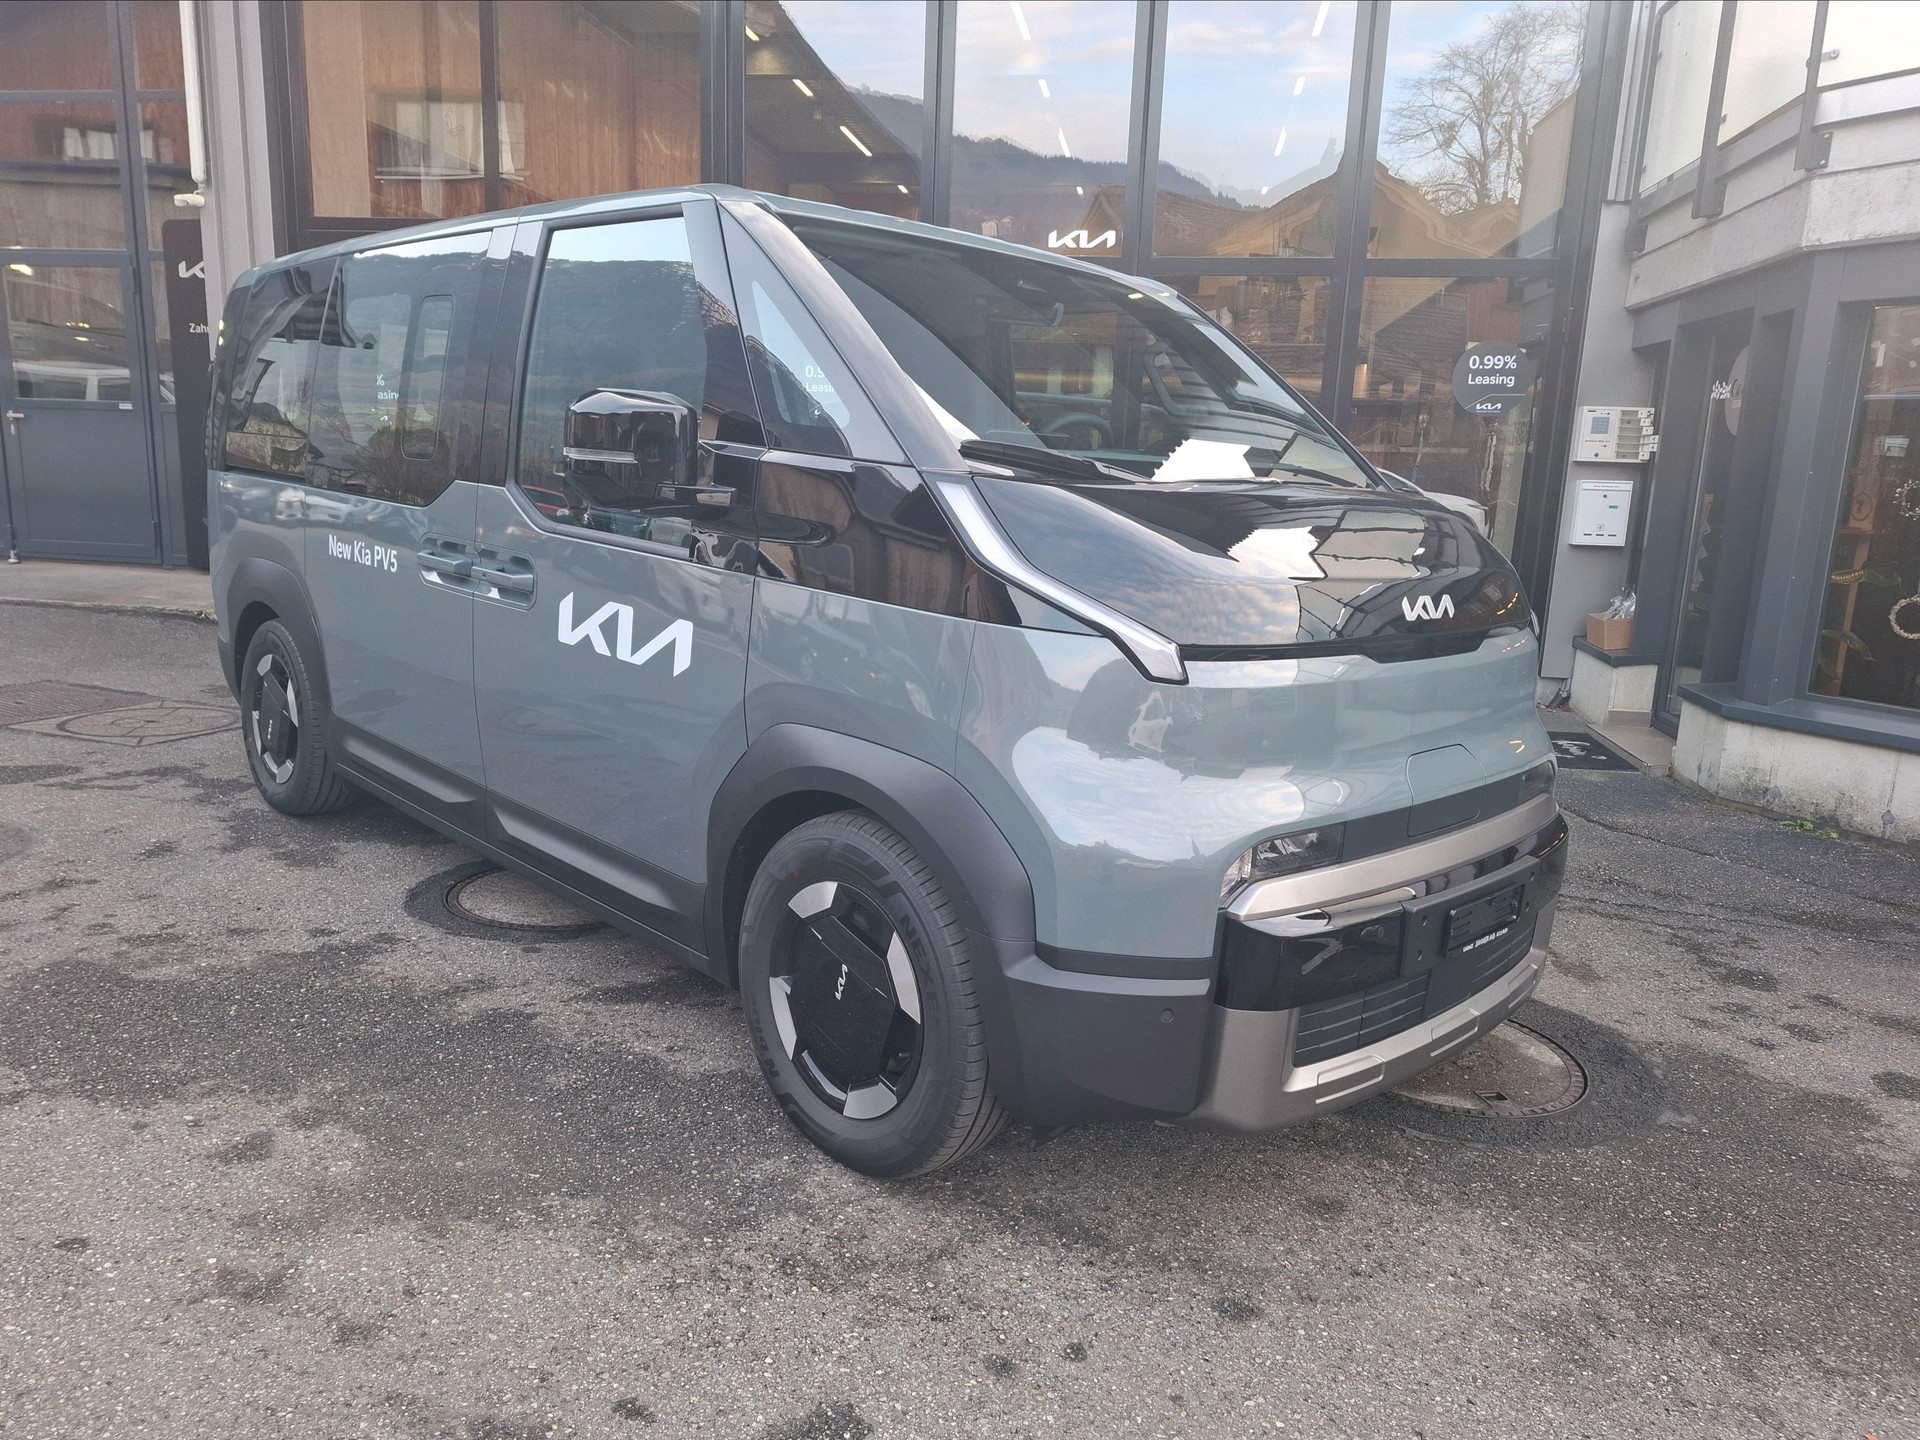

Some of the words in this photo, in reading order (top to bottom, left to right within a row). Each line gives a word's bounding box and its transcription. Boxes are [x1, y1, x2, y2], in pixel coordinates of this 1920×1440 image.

[1047, 229, 1116, 249] KIA
[1469, 355, 1517, 369] 0.99%
[1468, 373, 1515, 387] Leasing
[1475, 402, 1502, 410] KIA
[328, 534, 352, 560] New
[354, 540, 371, 566] Kia
[374, 545, 398, 573] PV5
[1401, 594, 1455, 622] KIA
[558, 591, 694, 677] KIA
